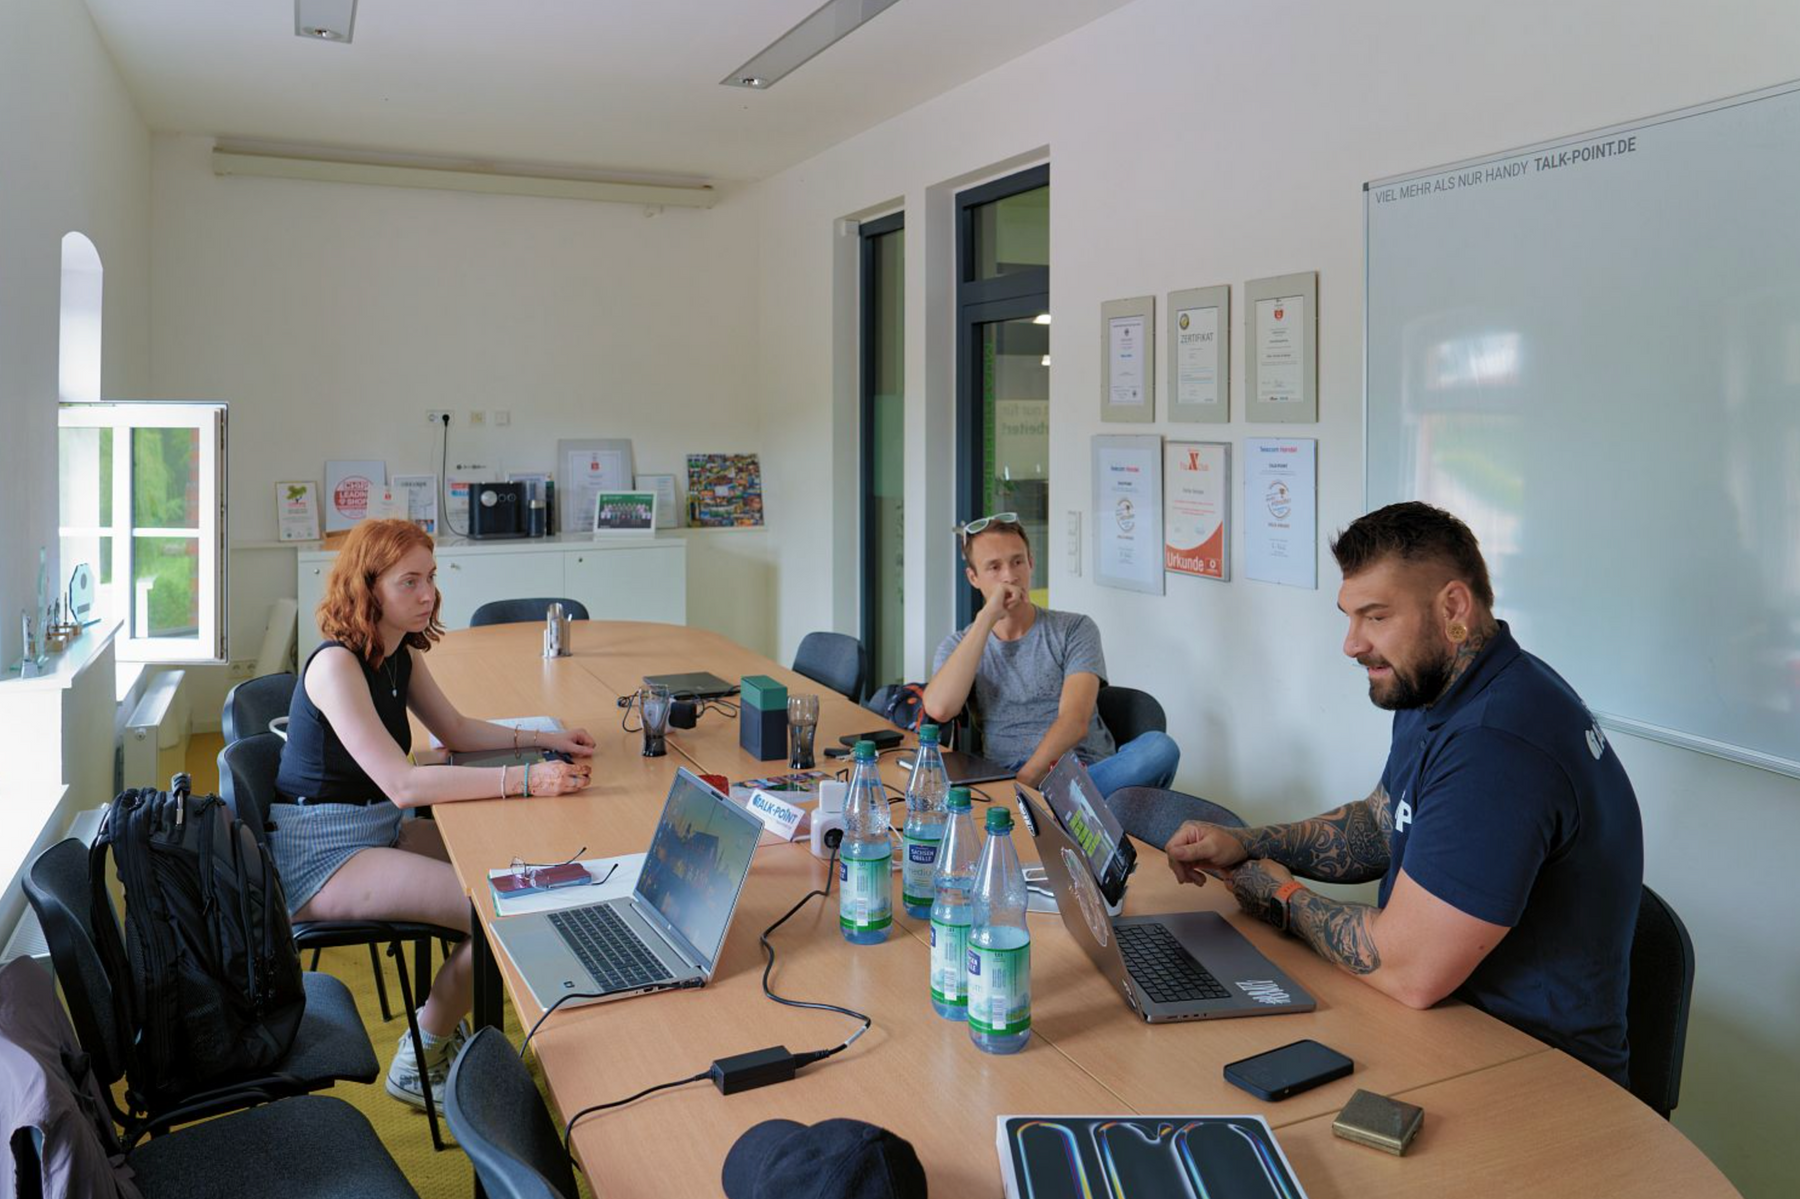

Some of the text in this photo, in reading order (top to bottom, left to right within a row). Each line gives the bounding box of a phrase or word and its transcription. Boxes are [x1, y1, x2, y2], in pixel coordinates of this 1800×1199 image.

[1375, 137, 1636, 203] VIEL MEHR ALS NUR HANDY TALK-POINT.DE
[1180, 332, 1214, 343] ZERTIFIKAT
[340, 490, 367, 499] LEADIN
[1167, 551, 1204, 572] Urkunde
[754, 795, 798, 824] TALK-POINT
